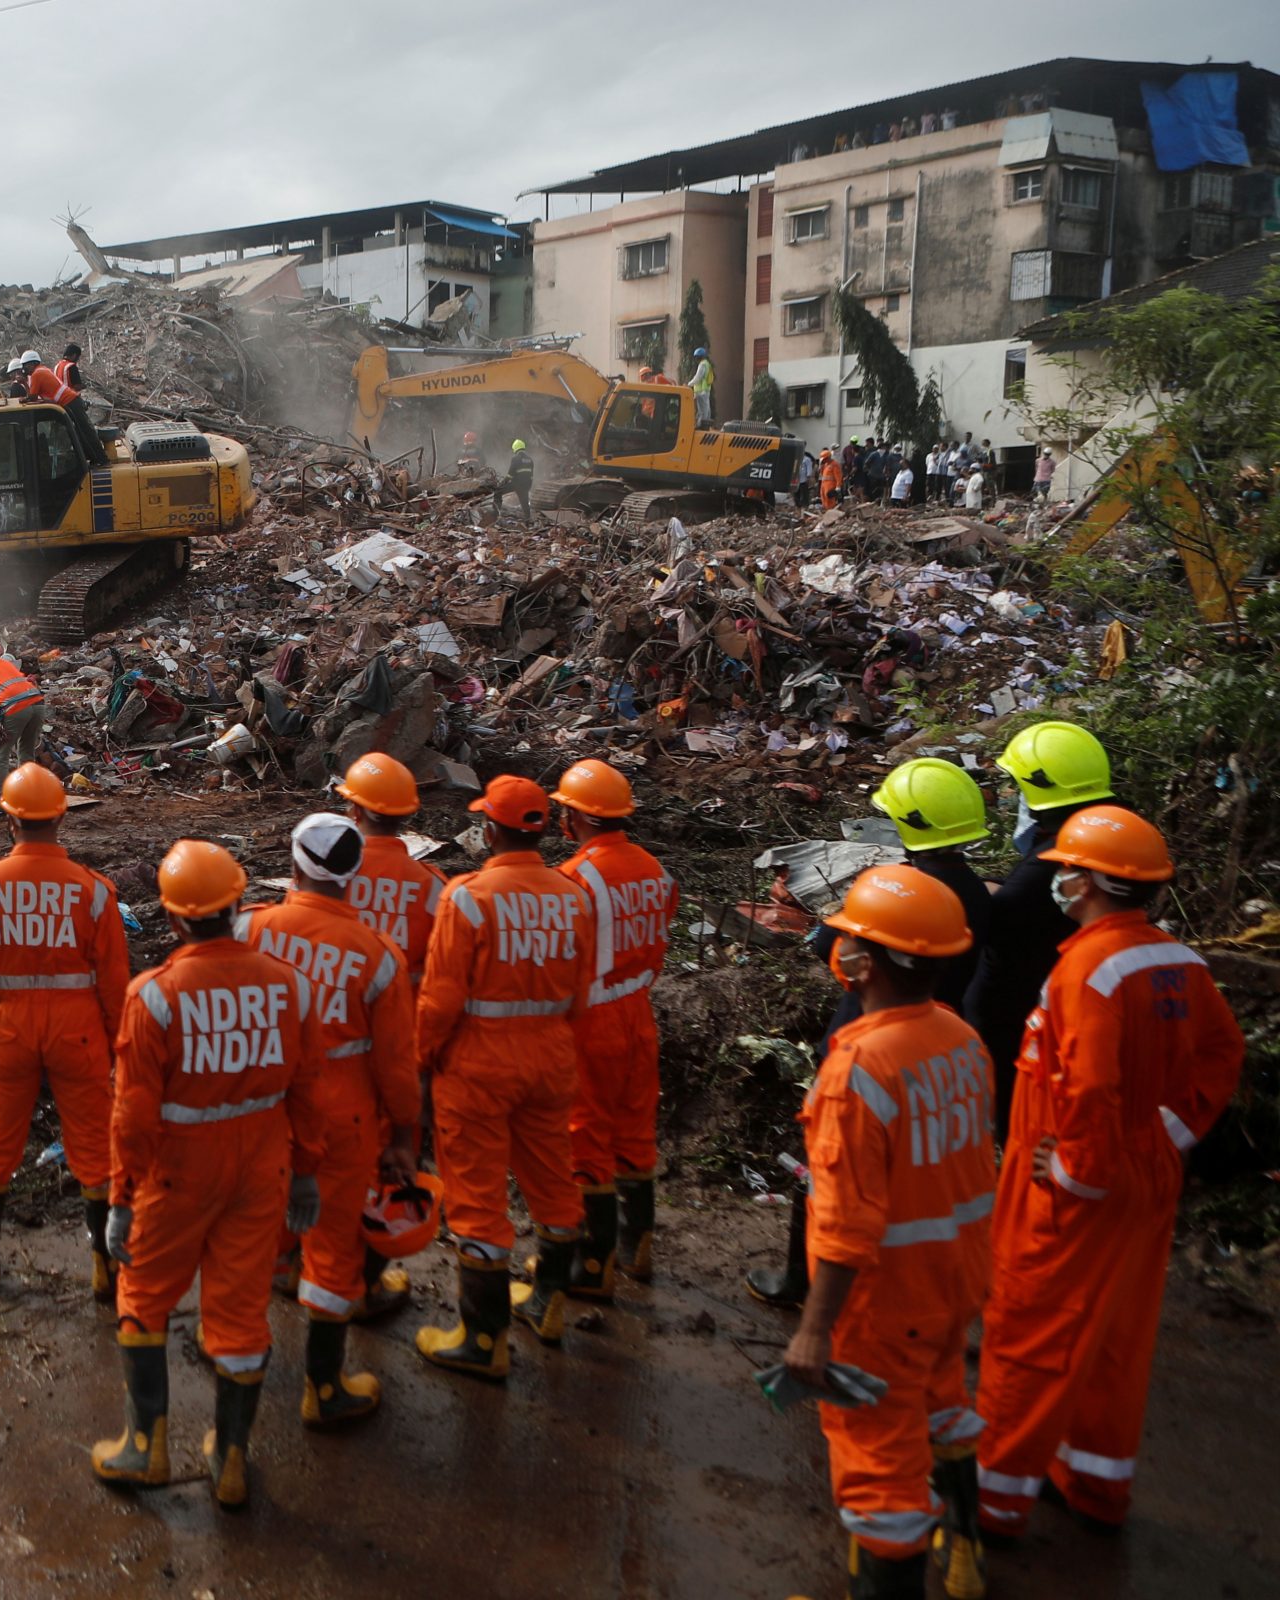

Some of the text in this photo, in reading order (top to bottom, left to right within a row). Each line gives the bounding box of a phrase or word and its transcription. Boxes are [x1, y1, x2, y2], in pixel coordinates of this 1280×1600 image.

[421, 373, 486, 391] HYUNDAI
[750, 467, 772, 479] 210
[169, 511, 215, 524] PC200
[350, 875, 421, 915] DRF
[493, 891, 580, 931] NDRF
[608, 877, 670, 917] NDRF
[259, 927, 367, 990] NDRF
[178, 983, 289, 1035] NDRF
[182, 1028, 285, 1074] INDIA
